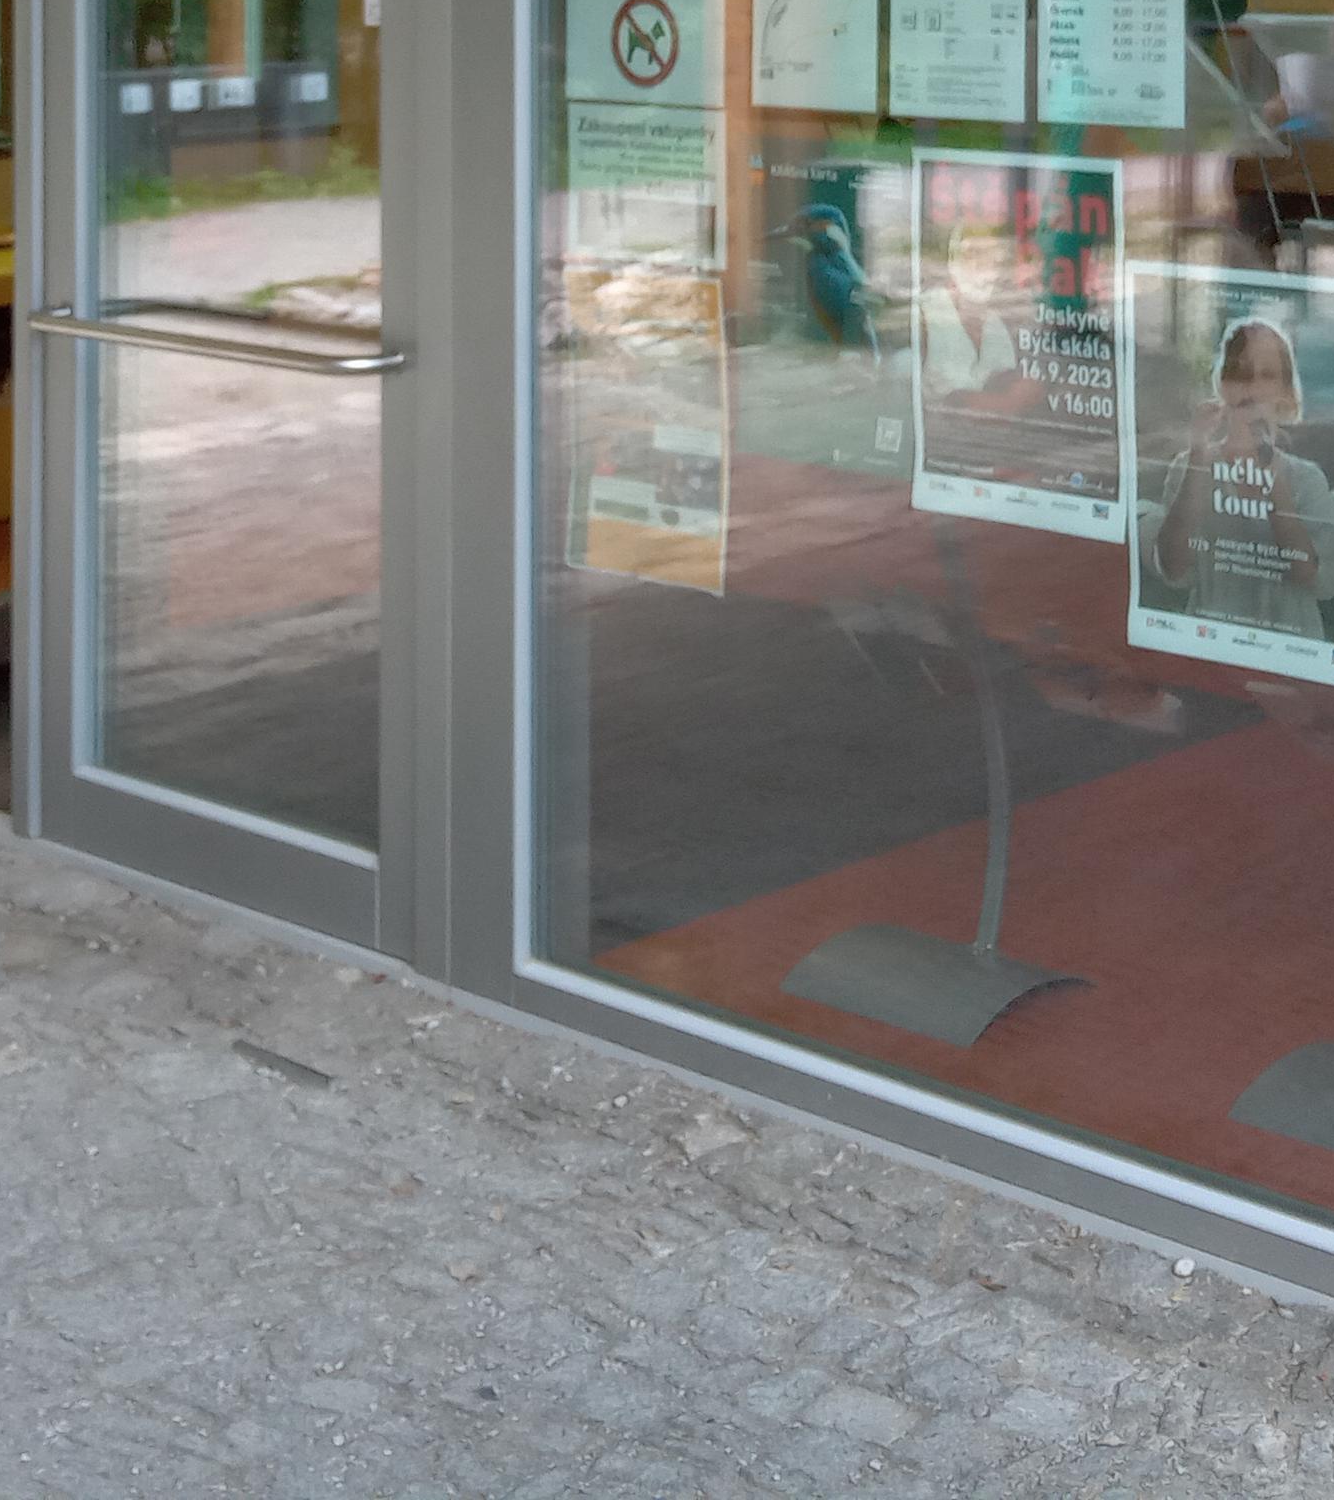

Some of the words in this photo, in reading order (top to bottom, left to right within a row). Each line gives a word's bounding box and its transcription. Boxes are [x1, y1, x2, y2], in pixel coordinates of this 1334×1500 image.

[1035, 302, 1110, 334] Jeskyně
[1019, 327, 1057, 357] Býčí
[1060, 333, 1111, 361] skála
[1064, 391, 1113, 419] 16:00
[1212, 456, 1275, 496] něhy
[1212, 487, 1276, 522] tour
